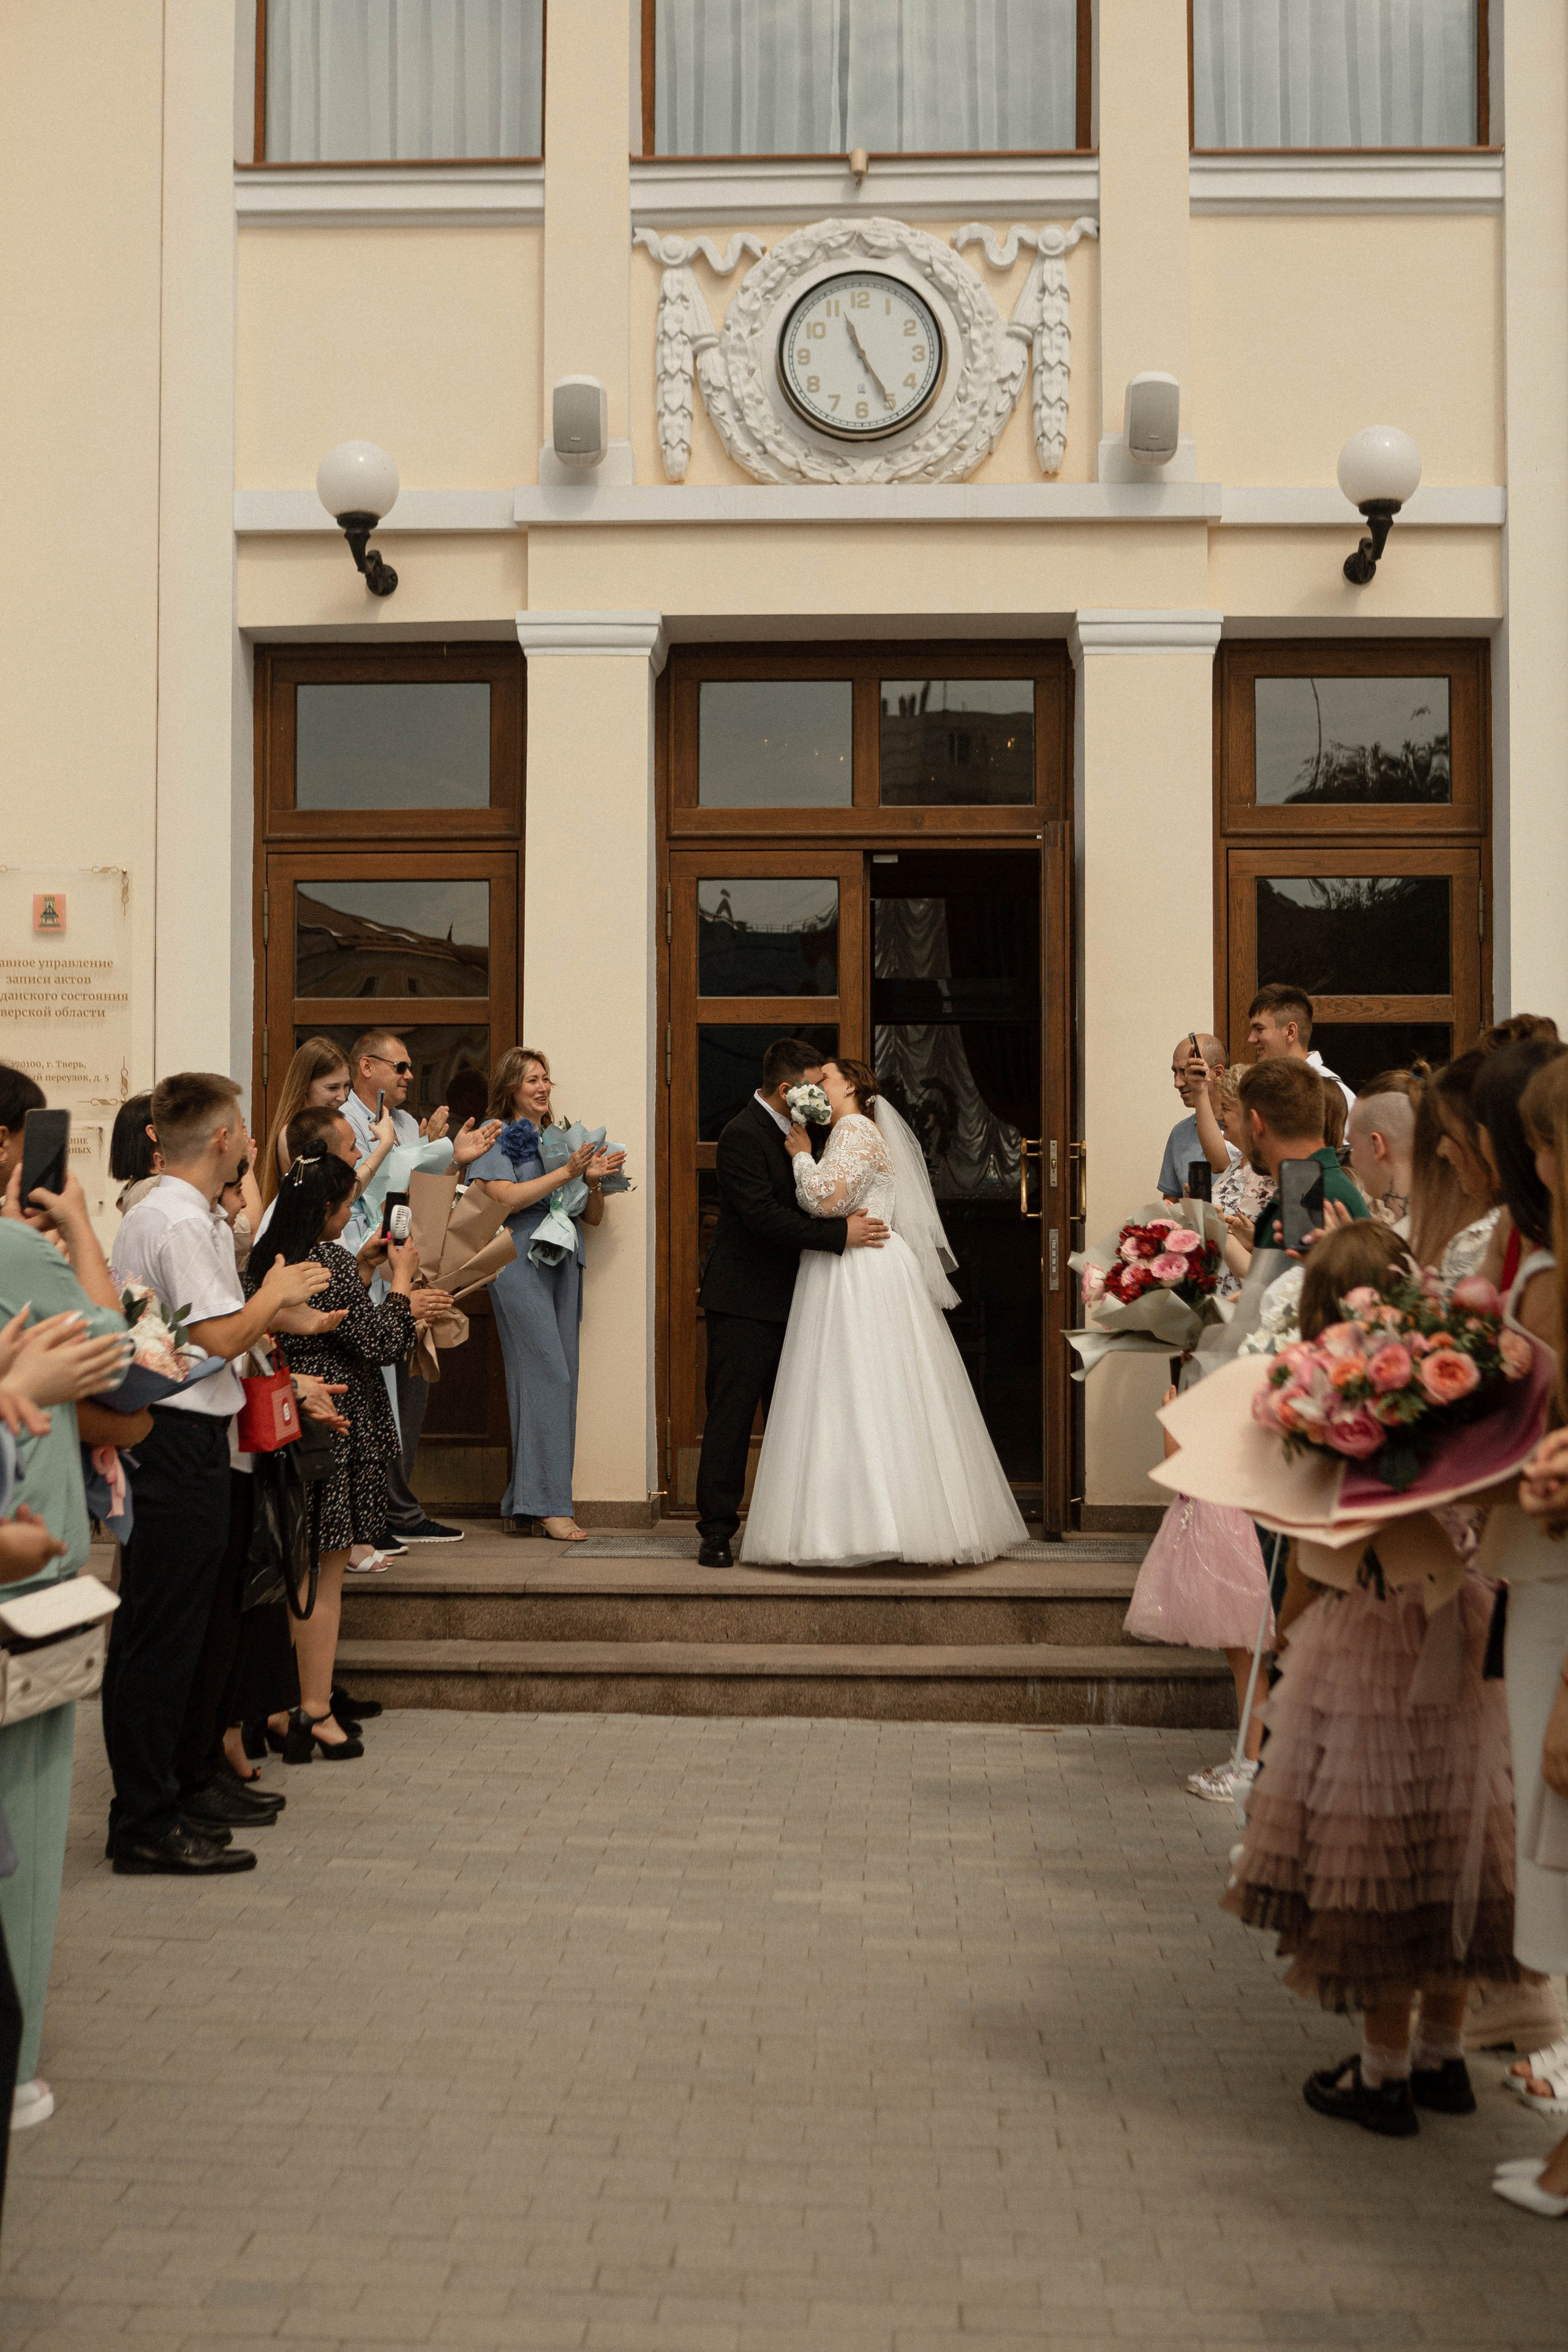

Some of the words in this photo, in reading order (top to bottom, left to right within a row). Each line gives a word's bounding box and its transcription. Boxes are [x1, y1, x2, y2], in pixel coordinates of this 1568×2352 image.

[827, 300, 840, 317] 11
[850, 291, 870, 309] 12
[885, 298, 891, 315] 1
[806, 322, 826, 339] 10
[903, 319, 917, 336] 2
[797, 348, 810, 366] 9
[911, 344, 925, 362] 3
[807, 375, 820, 393] 8
[903, 372, 917, 390] 4
[828, 394, 841, 412] 7
[855, 401, 869, 419] 6
[883, 393, 896, 410] 5
[38, 959, 114, 970] управление
[6, 976, 51, 985] записи
[54, 976, 92, 985] актов
[61, 992, 129, 1001] состояния
[55, 1006, 106, 1017] области
[56, 1060, 86, 1070] Тверь,
[45, 1074, 91, 1083] переулок,
